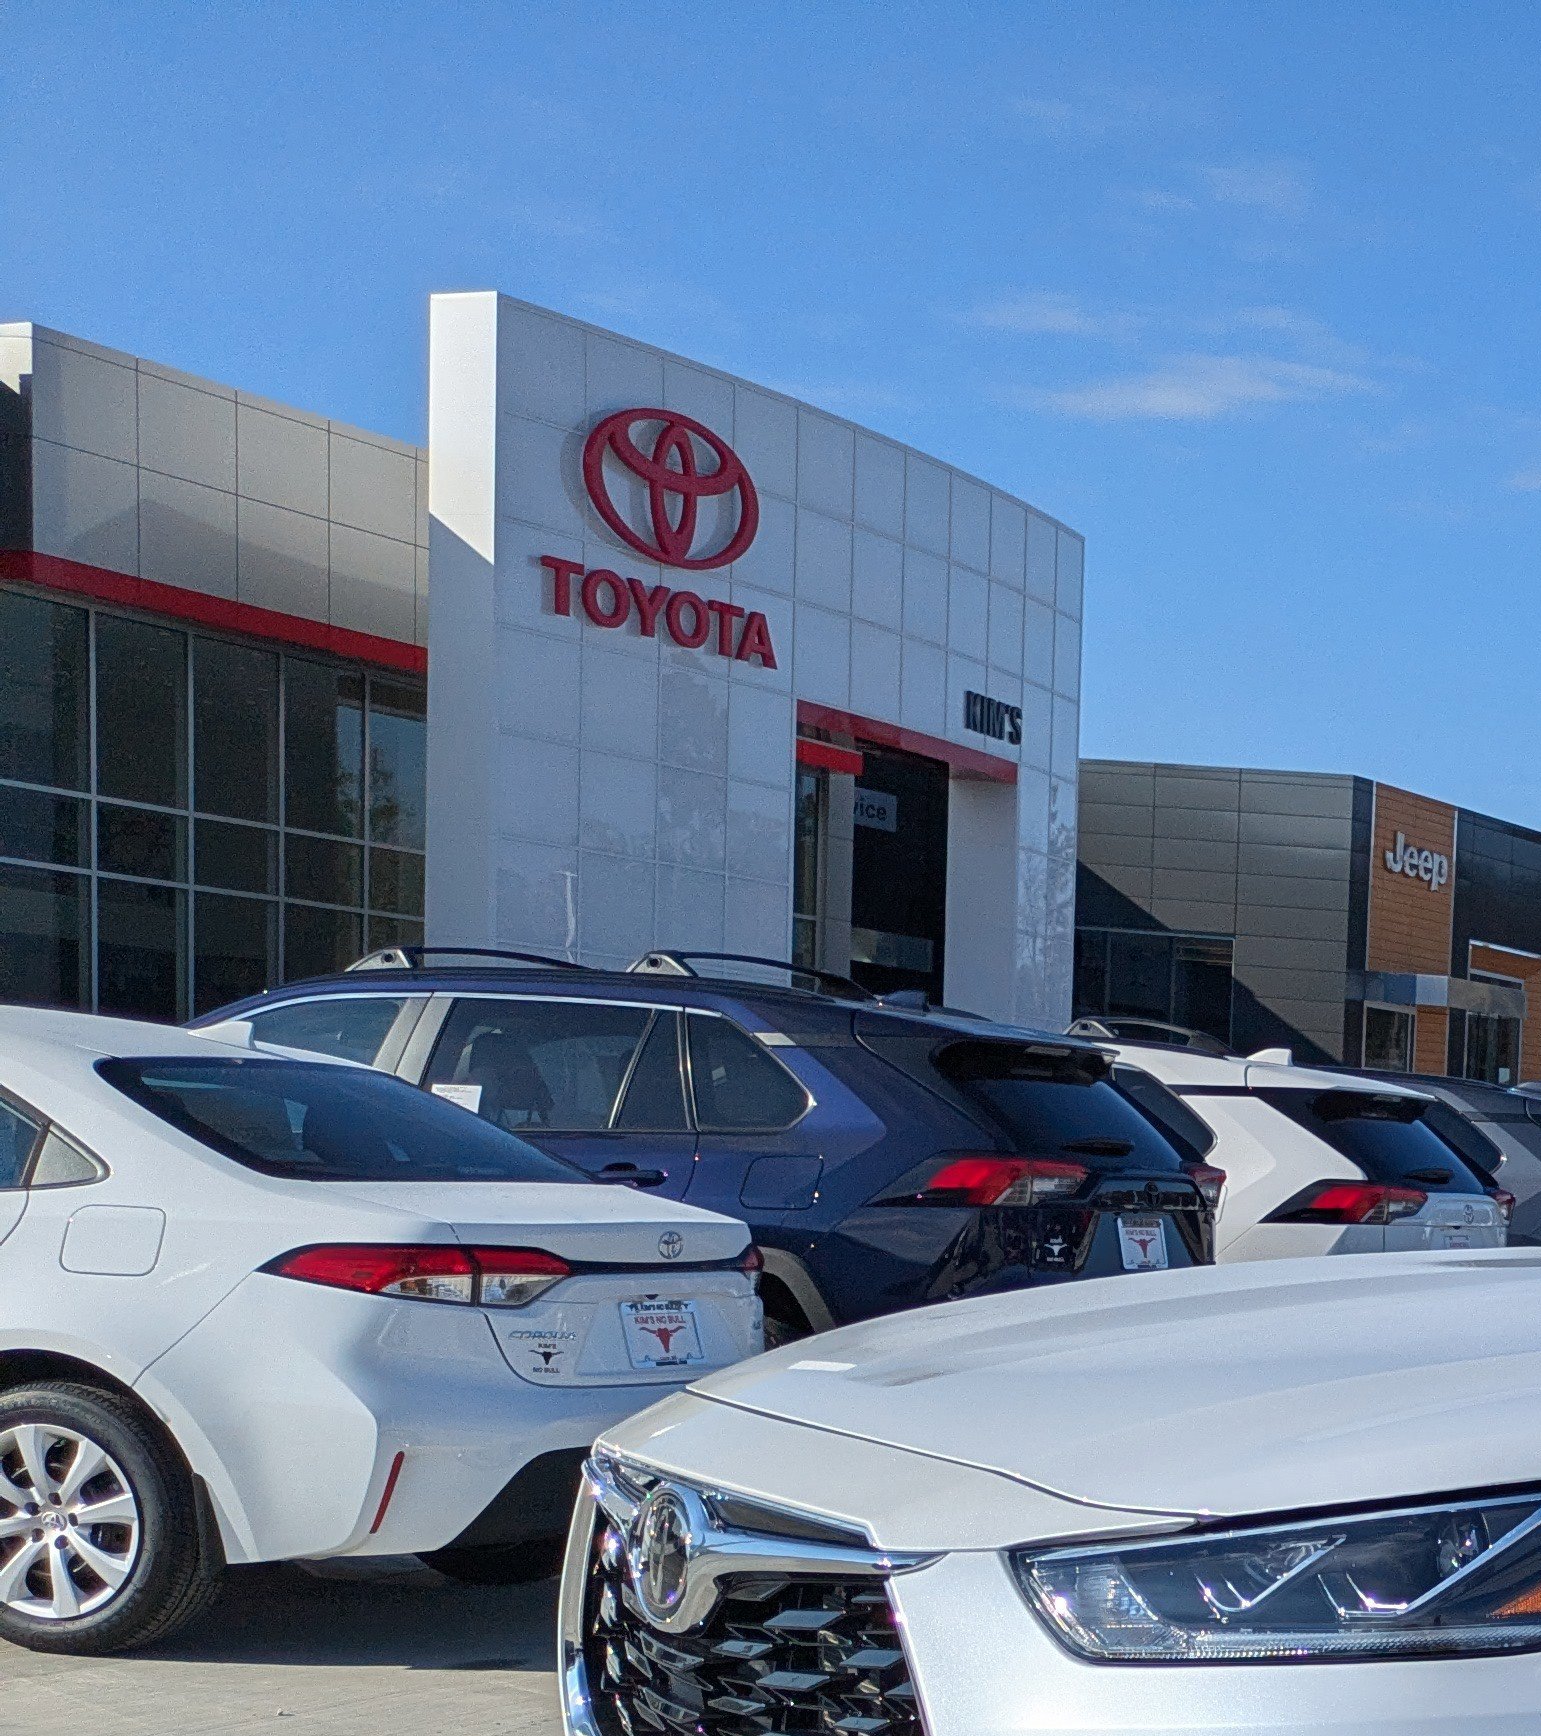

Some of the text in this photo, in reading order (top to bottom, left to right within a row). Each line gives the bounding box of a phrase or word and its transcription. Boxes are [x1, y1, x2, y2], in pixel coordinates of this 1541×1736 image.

[540, 555, 778, 670] TOYOTA
[964, 690, 1022, 745] KIM'S
[1384, 831, 1448, 892] Jeep
